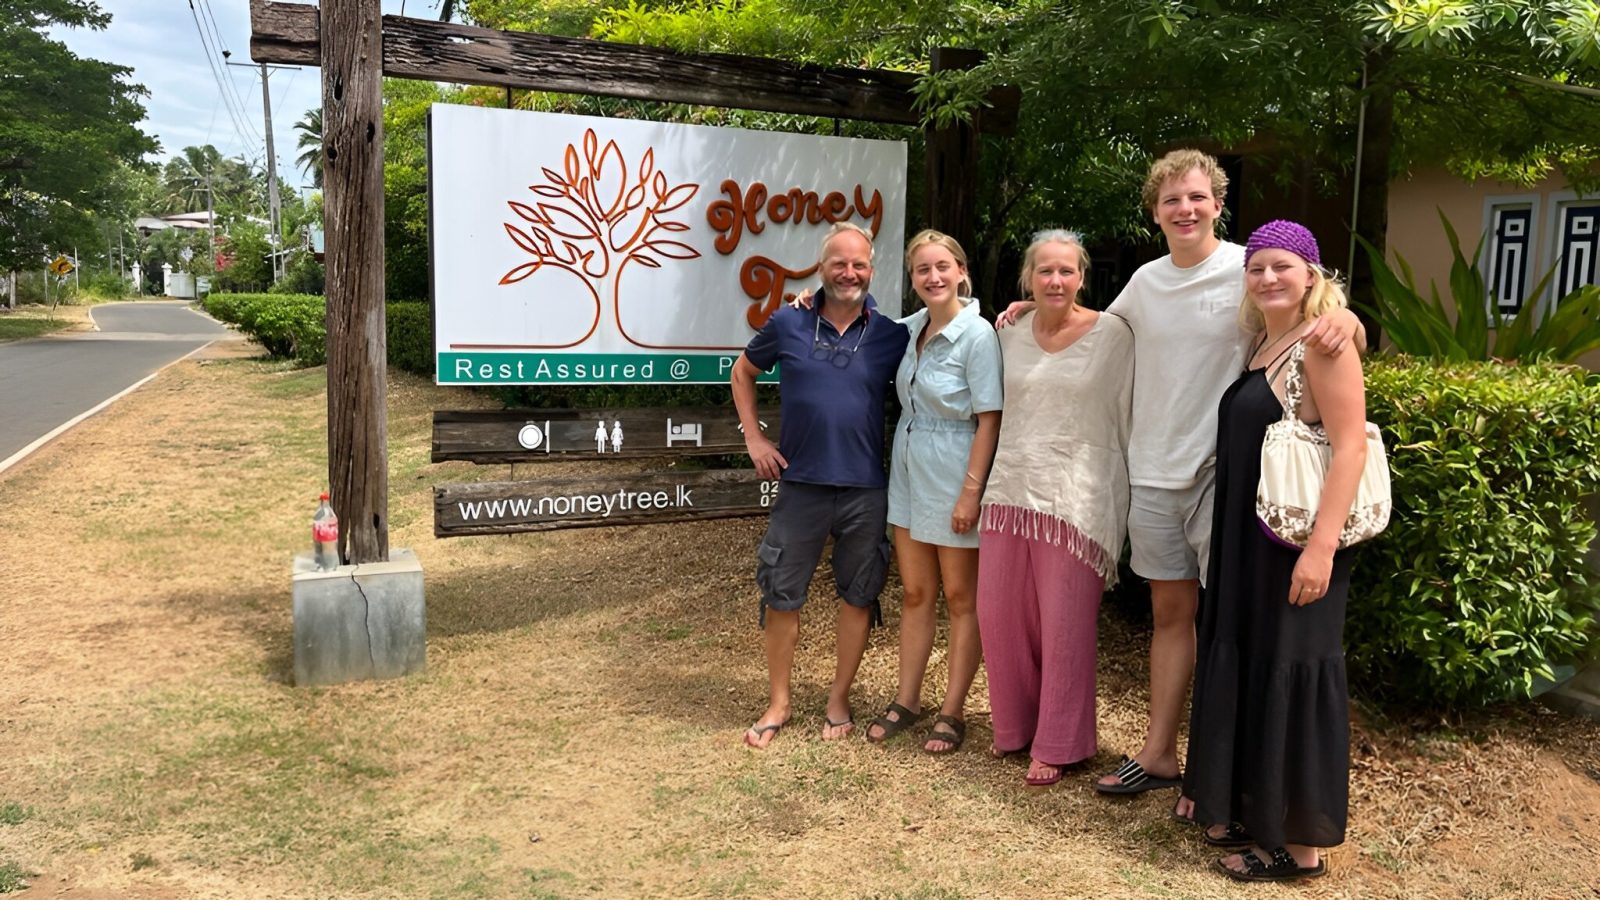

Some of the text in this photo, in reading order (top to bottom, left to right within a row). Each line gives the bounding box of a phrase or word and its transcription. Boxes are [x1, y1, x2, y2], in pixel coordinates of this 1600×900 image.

[706, 179, 882, 255] Honey
[455, 358, 690, 380] Rest Assured @
